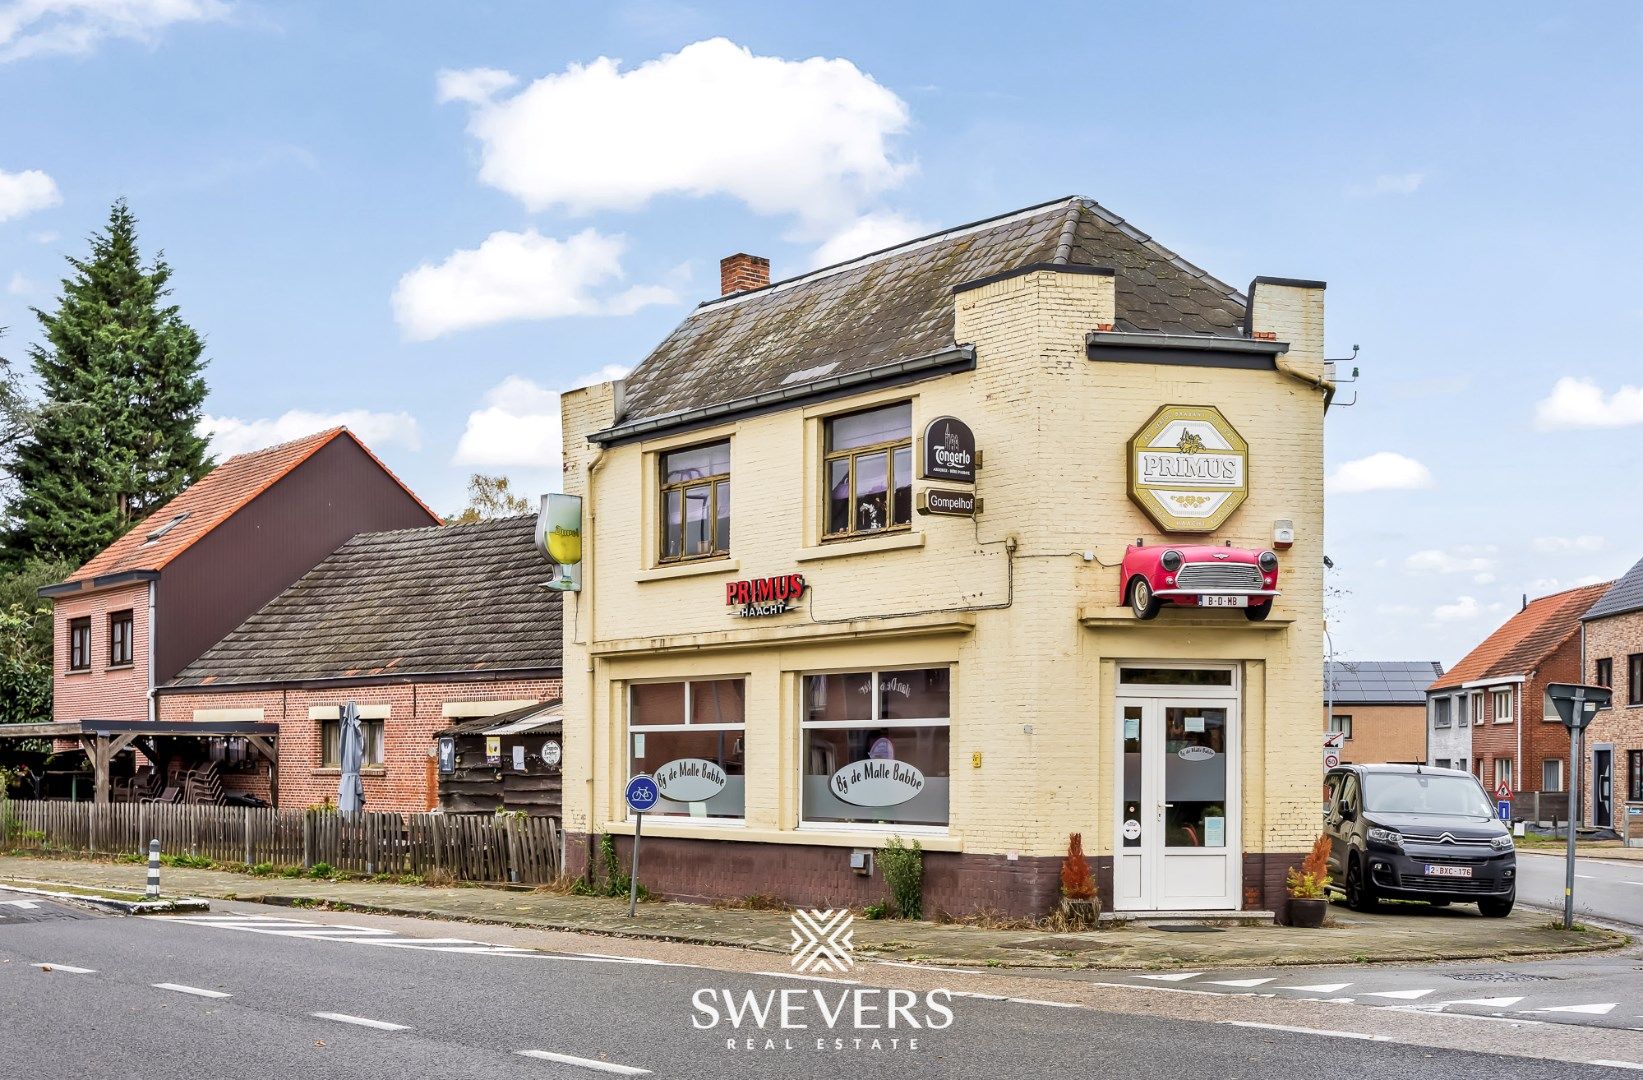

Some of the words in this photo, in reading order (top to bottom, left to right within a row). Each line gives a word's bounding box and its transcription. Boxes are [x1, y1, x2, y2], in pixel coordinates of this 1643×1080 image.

[933, 445, 971, 468] Tongerlo
[1144, 455, 1236, 479] PRIMUS
[930, 495, 973, 510] Gompelhof
[726, 573, 804, 606] PRIMUS
[741, 604, 785, 617] HAACHT
[669, 768, 677, 781] de
[680, 761, 699, 777] Malle
[701, 763, 725, 787] Babbe
[851, 769, 861, 784] de
[864, 762, 890, 780] Malle
[893, 763, 922, 790] Babbe
